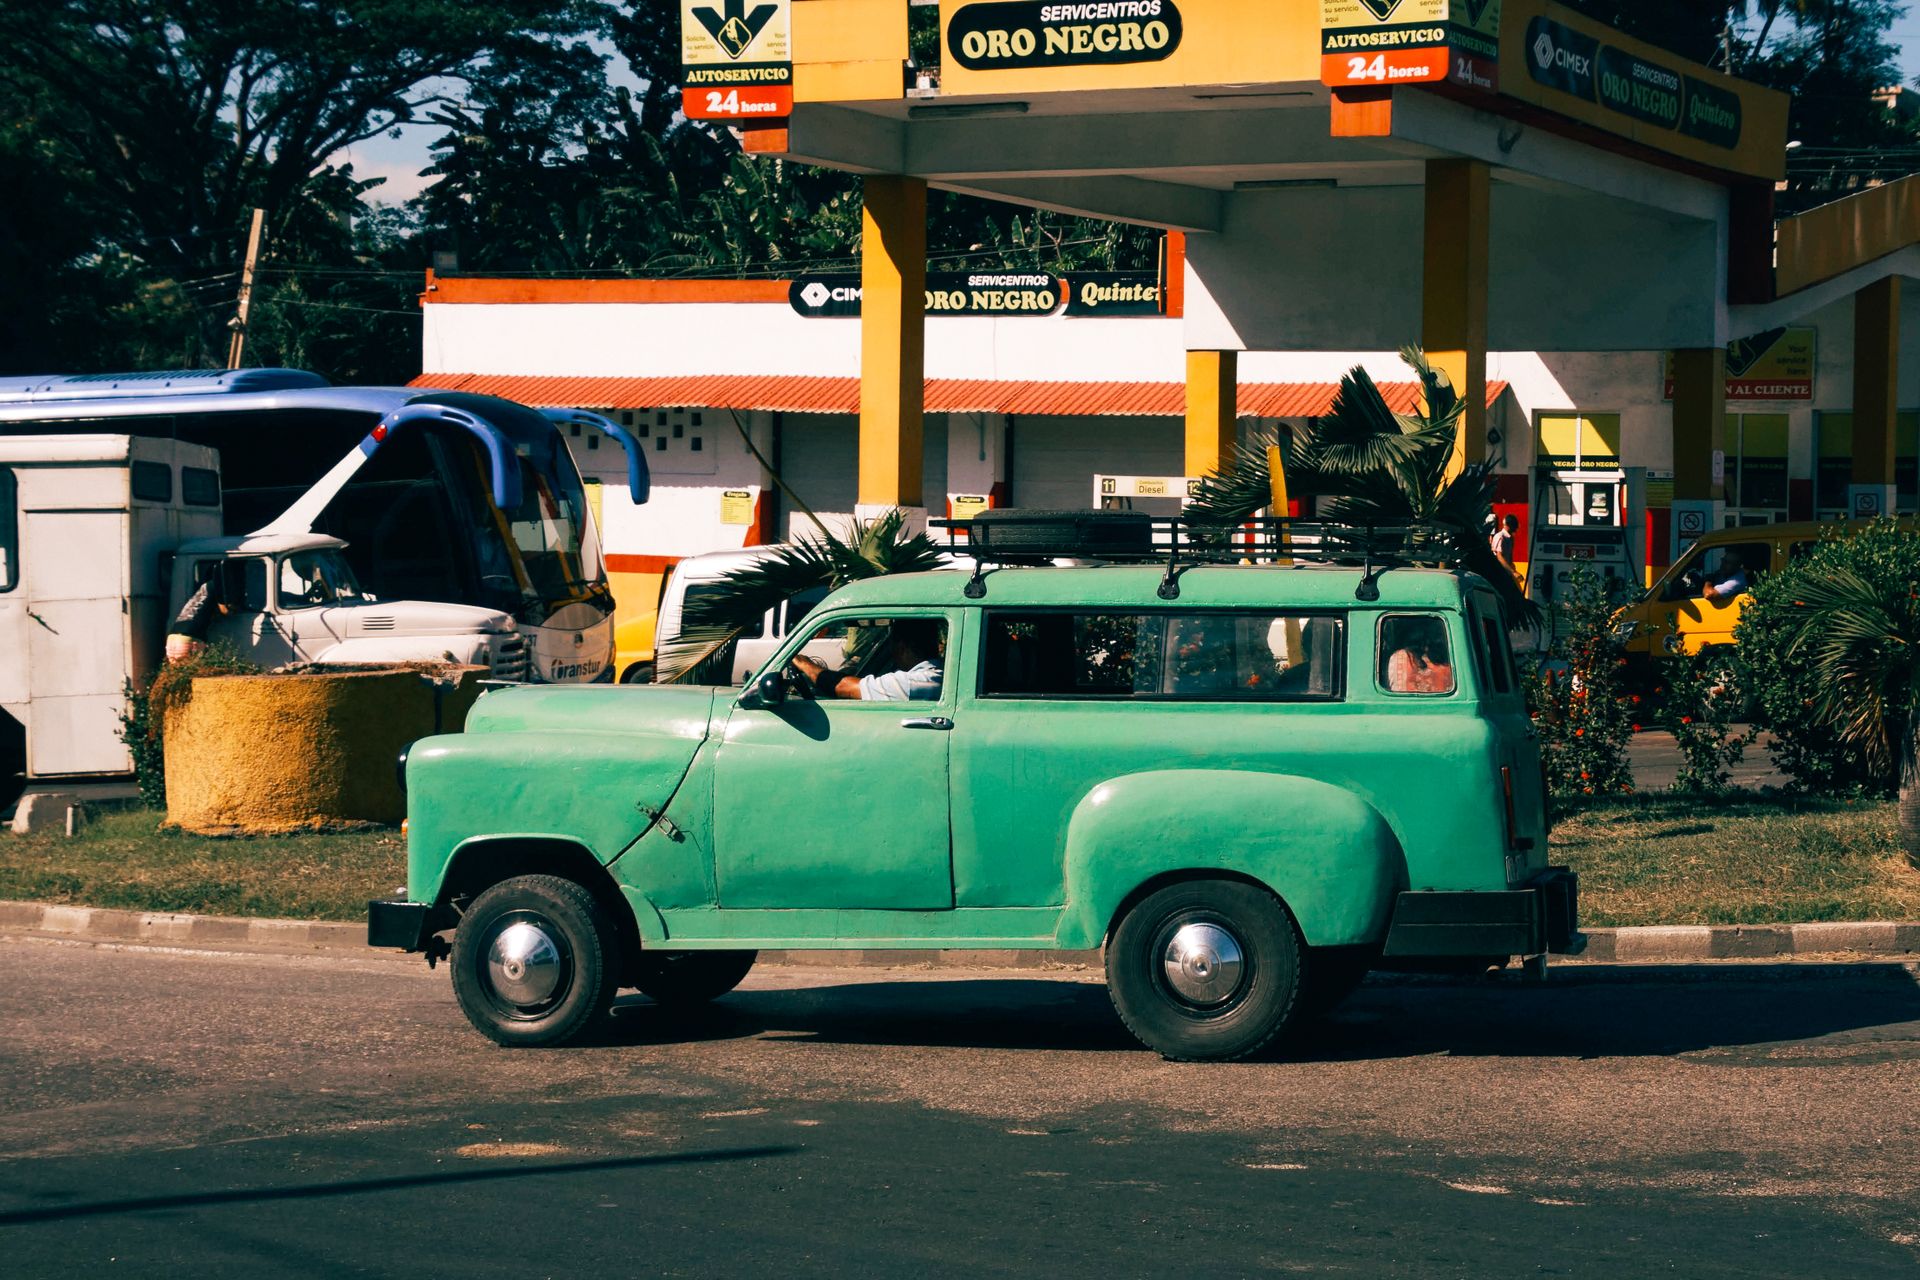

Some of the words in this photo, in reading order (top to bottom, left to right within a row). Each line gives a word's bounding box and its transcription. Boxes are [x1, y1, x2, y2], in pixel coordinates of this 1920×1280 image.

[1041, 0, 1162, 22] SERVICENTROS
[1334, 5, 1359, 13] servicio
[962, 28, 1036, 59] ORO
[1043, 20, 1170, 55] NEGRO
[1326, 28, 1445, 49] AUTOSERVICIO
[1347, 54, 1386, 81] 24
[1388, 65, 1430, 78] horas
[1457, 57, 1472, 85] 24
[1472, 73, 1491, 88] horas
[1555, 48, 1589, 77] CIMEX
[686, 68, 789, 82] AUTOSERVICIO
[1632, 62, 1678, 91] SERVICENTROS
[705, 89, 739, 114] 24
[741, 101, 777, 113] horas
[1602, 71, 1630, 104] ORO
[1632, 81, 1677, 121] NEGRO
[1690, 93, 1736, 130] Quintero
[968, 275, 1049, 286] SERVICENTROS
[971, 290, 1055, 310] NEGRO
[1735, 385, 1752, 395] AL
[1754, 385, 1809, 395] CLIENTE
[1553, 460, 1576, 468] NEGRO
[1103, 480, 1115, 492] 11
[1138, 485, 1164, 494] Diesel
[1188, 481, 1201, 494] 12
